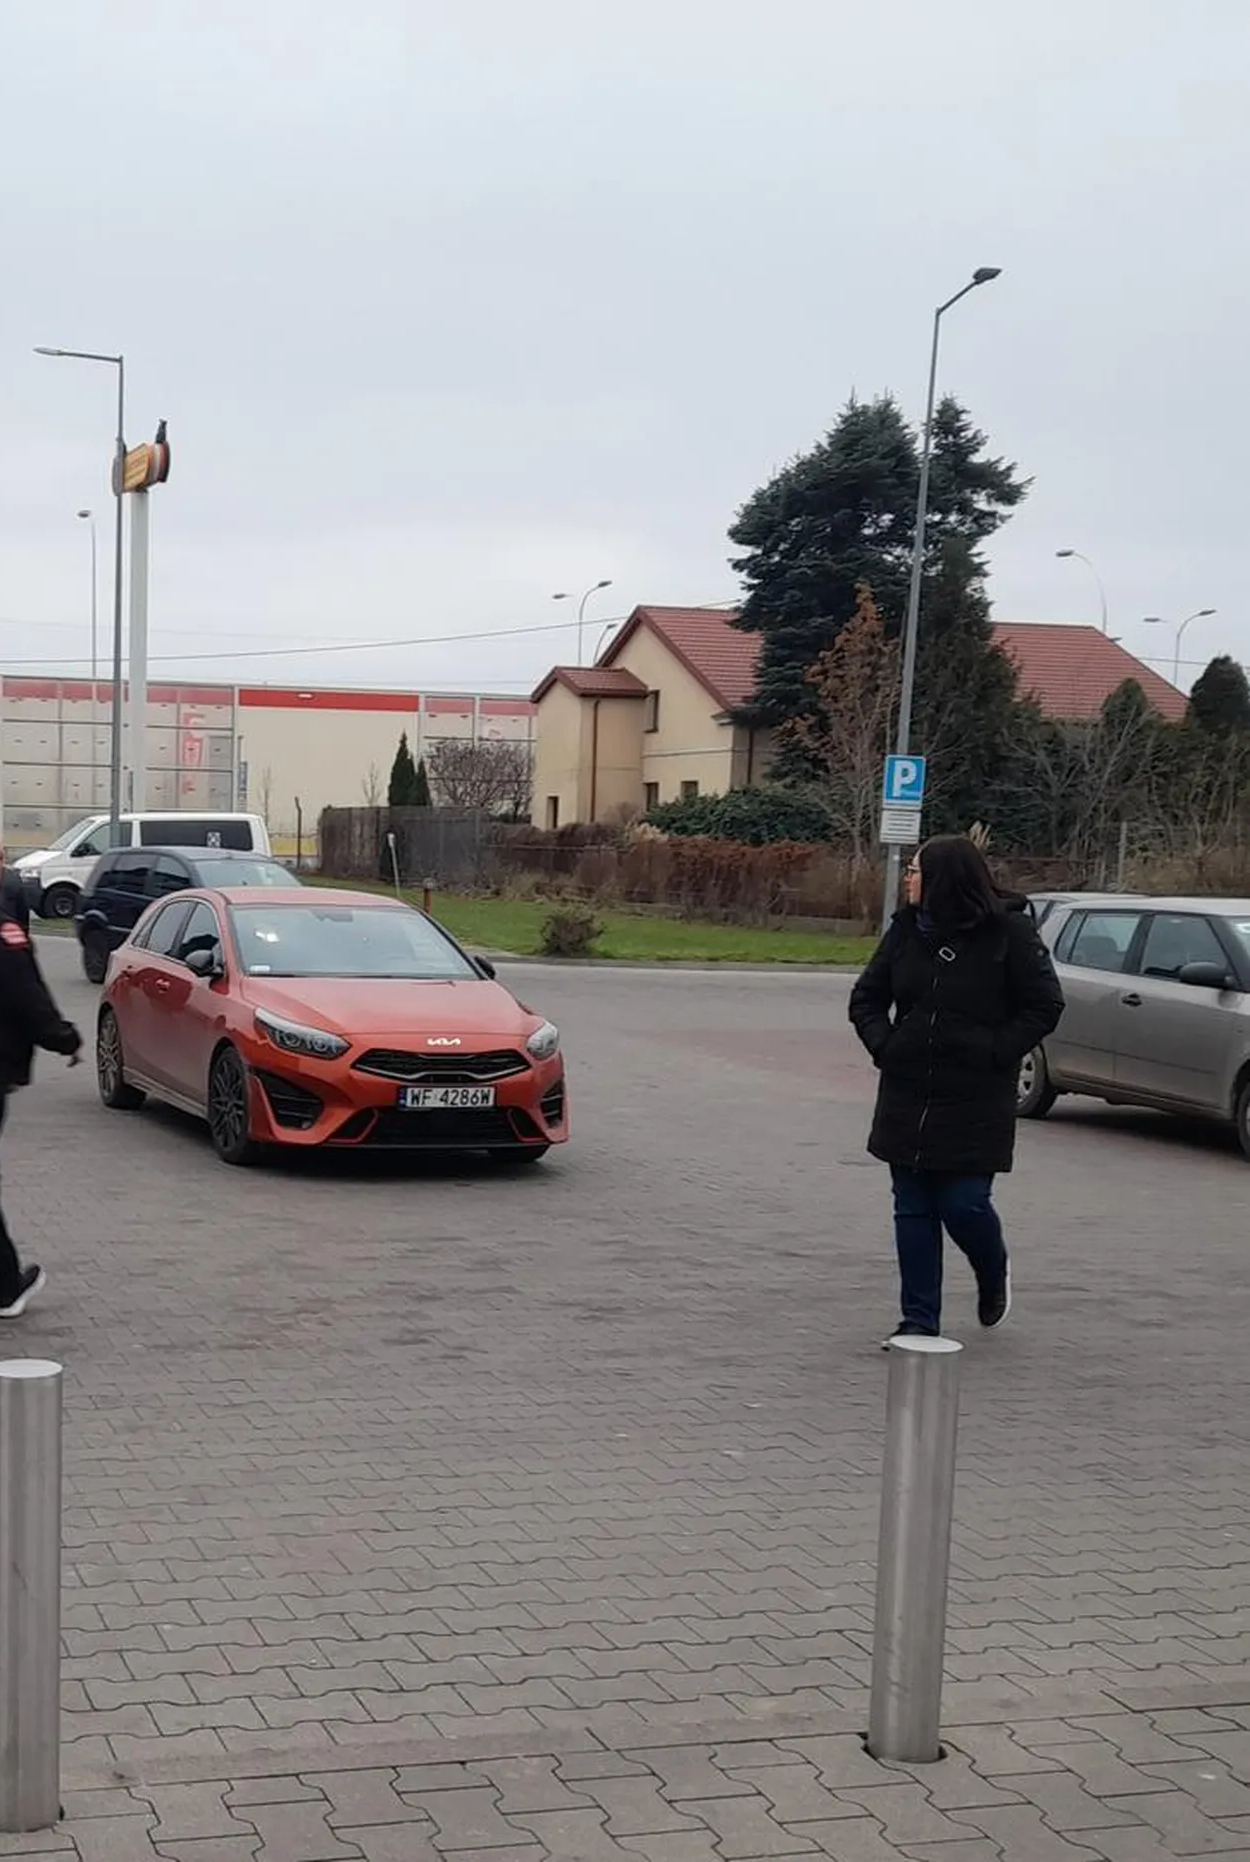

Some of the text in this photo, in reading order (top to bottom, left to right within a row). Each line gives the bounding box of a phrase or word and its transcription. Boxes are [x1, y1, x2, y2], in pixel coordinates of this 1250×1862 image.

[892, 760, 918, 797] P
[410, 1089, 491, 1106] WF 4286W
